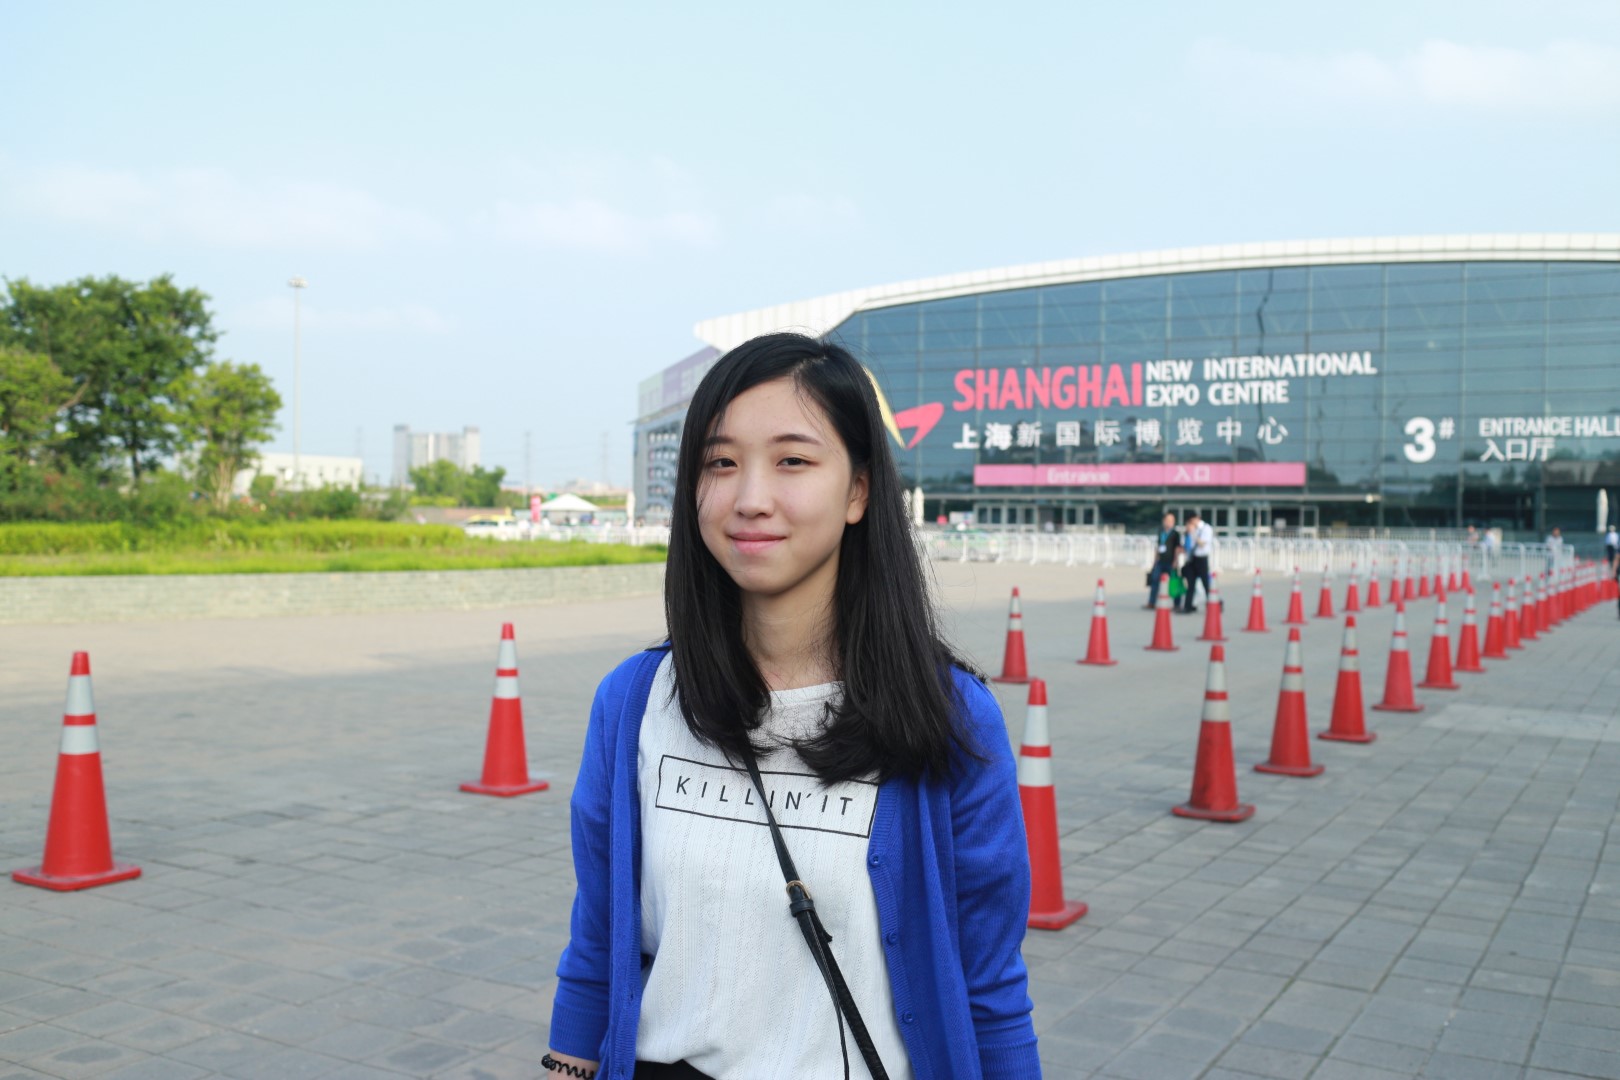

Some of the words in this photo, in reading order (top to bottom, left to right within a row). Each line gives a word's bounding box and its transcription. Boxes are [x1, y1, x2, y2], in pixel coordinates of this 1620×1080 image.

[1145, 358, 1193, 382] NEW
[1203, 352, 1378, 379] INTERNATIONAL
[952, 363, 1142, 411] SHANGHAI
[1145, 383, 1200, 407] EXPO
[1207, 380, 1289, 405] CENTRE
[952, 416, 1289, 451] 上海新国际博览中心
[1478, 416, 1573, 437] ENTRANCE
[1480, 437, 1555, 462] 入口厅
[1047, 467, 1111, 484] Entrance
[1173, 465, 1211, 482] 入口
